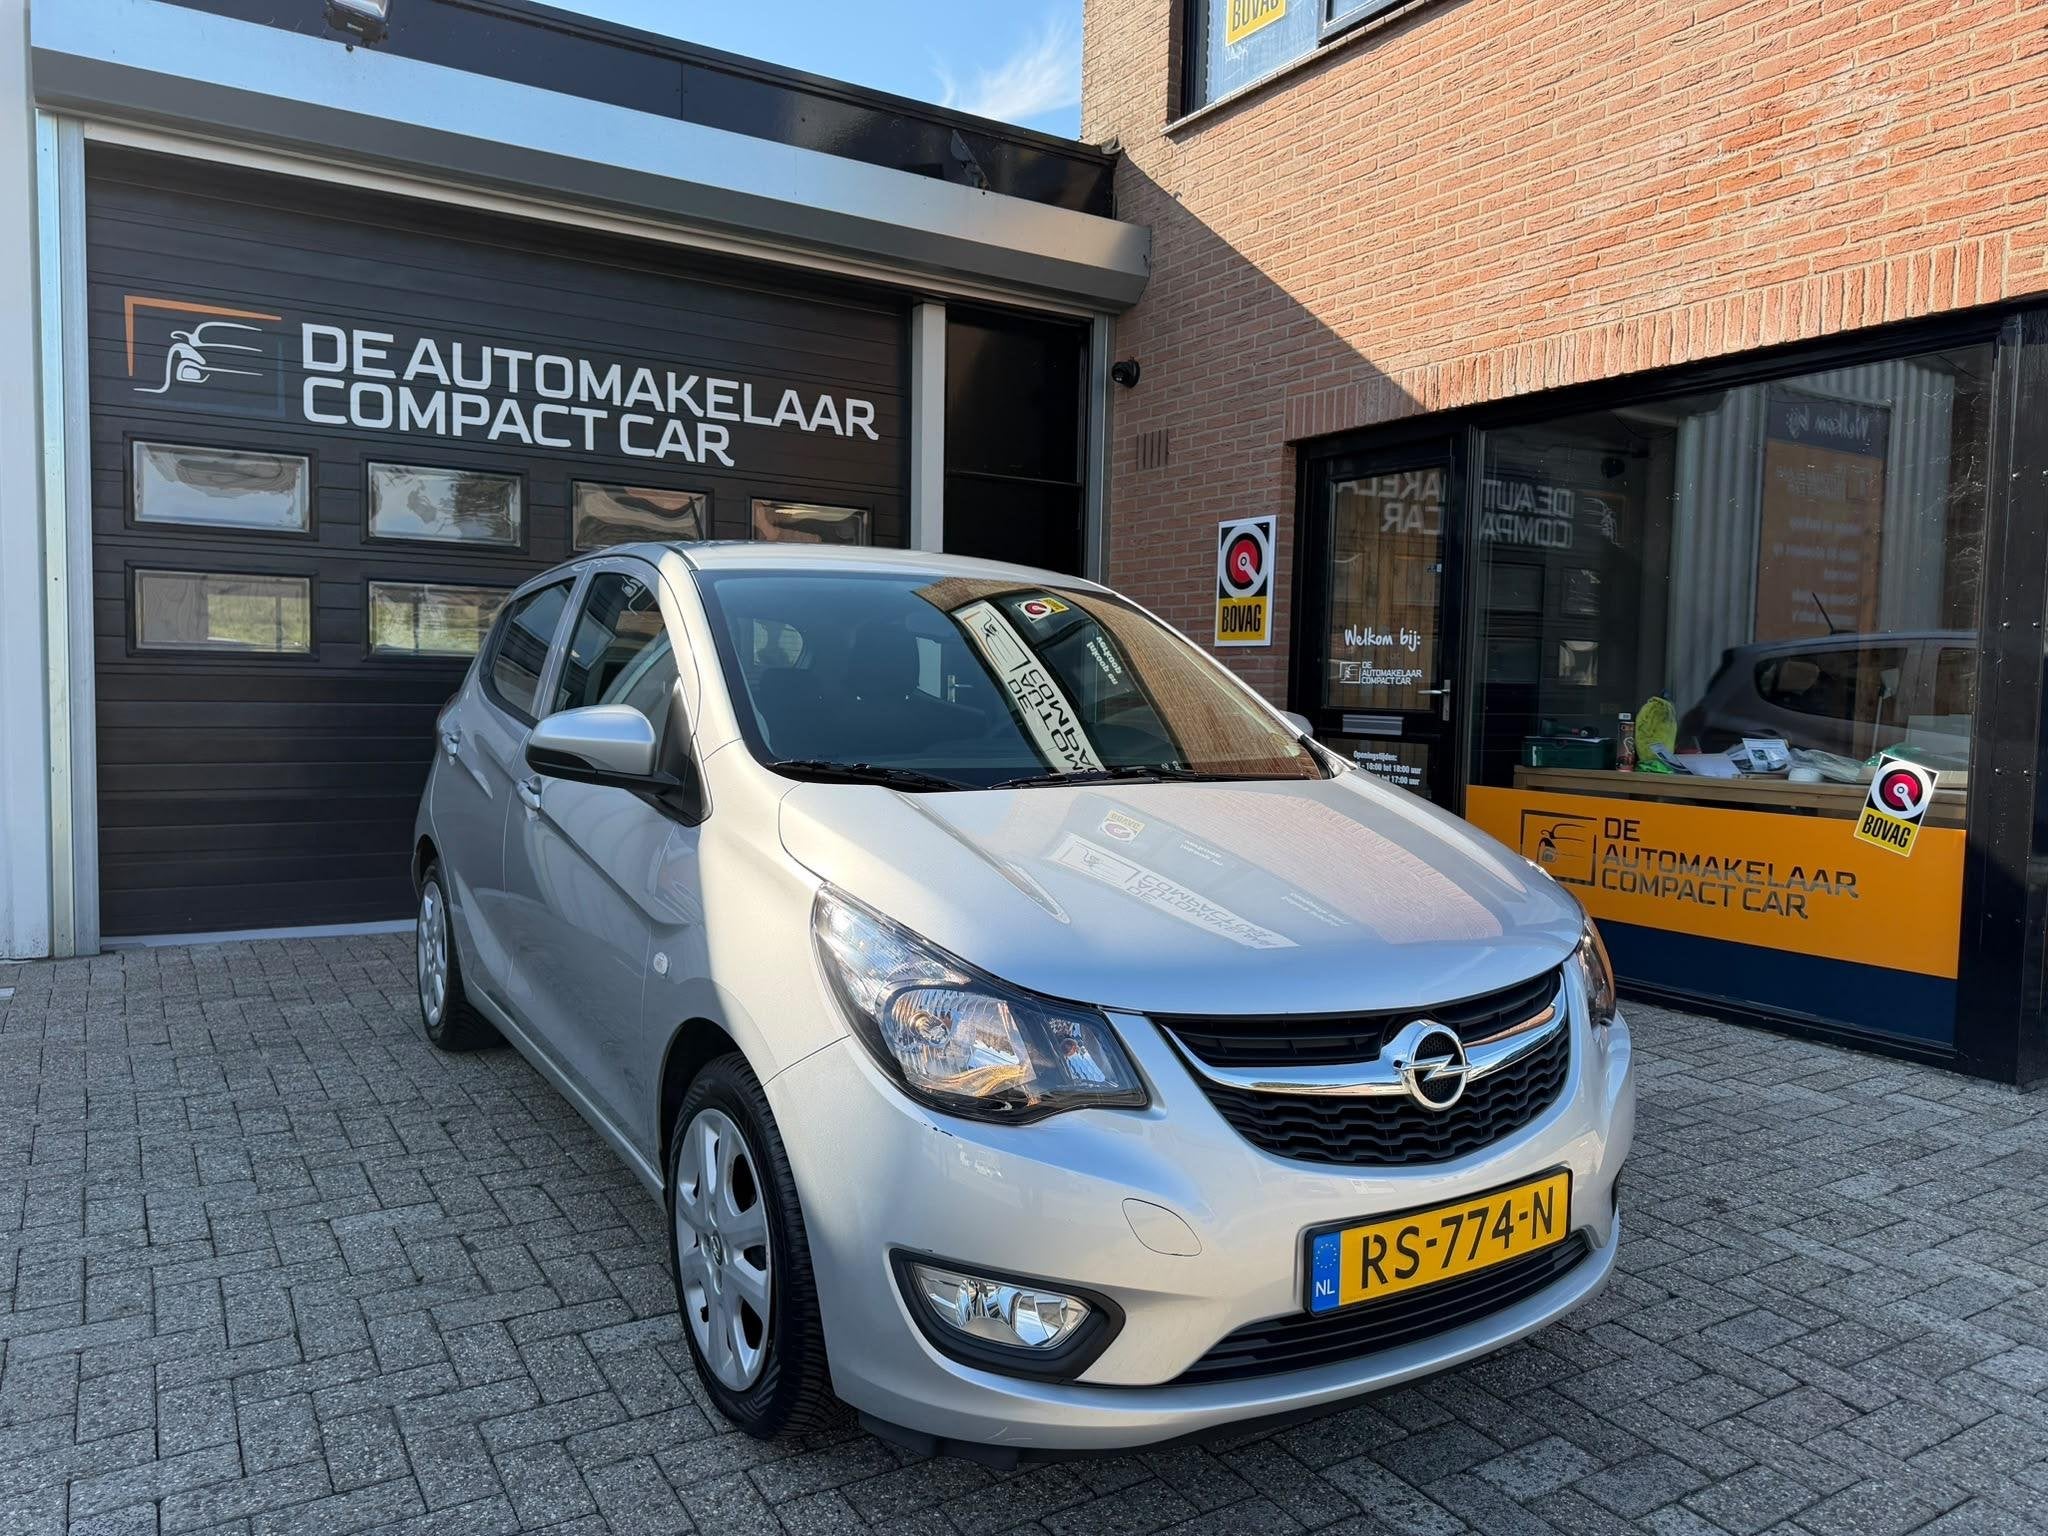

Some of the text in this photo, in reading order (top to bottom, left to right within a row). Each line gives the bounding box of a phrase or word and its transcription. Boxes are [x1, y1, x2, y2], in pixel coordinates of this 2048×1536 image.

[302, 322, 879, 441] DE AUTOMAKELAAR
[302, 375, 734, 467] COMPACT CAR
[1221, 604, 1262, 632] BOVAG
[1344, 624, 1421, 652] Welkom bij:
[1361, 661, 1374, 669] DE
[1361, 669, 1423, 678] AUTOMAKELAAR
[1361, 676, 1412, 685] COMPACT CAR
[1604, 816, 1640, 843] DE
[1862, 813, 1912, 848] BOVAG
[1602, 844, 1860, 899] AUTOMAKELAAR
[1601, 868, 1809, 921] COMPACT CAR
[1361, 1186, 1555, 1289] RS-774-N
[1315, 1279, 1336, 1298] NL
